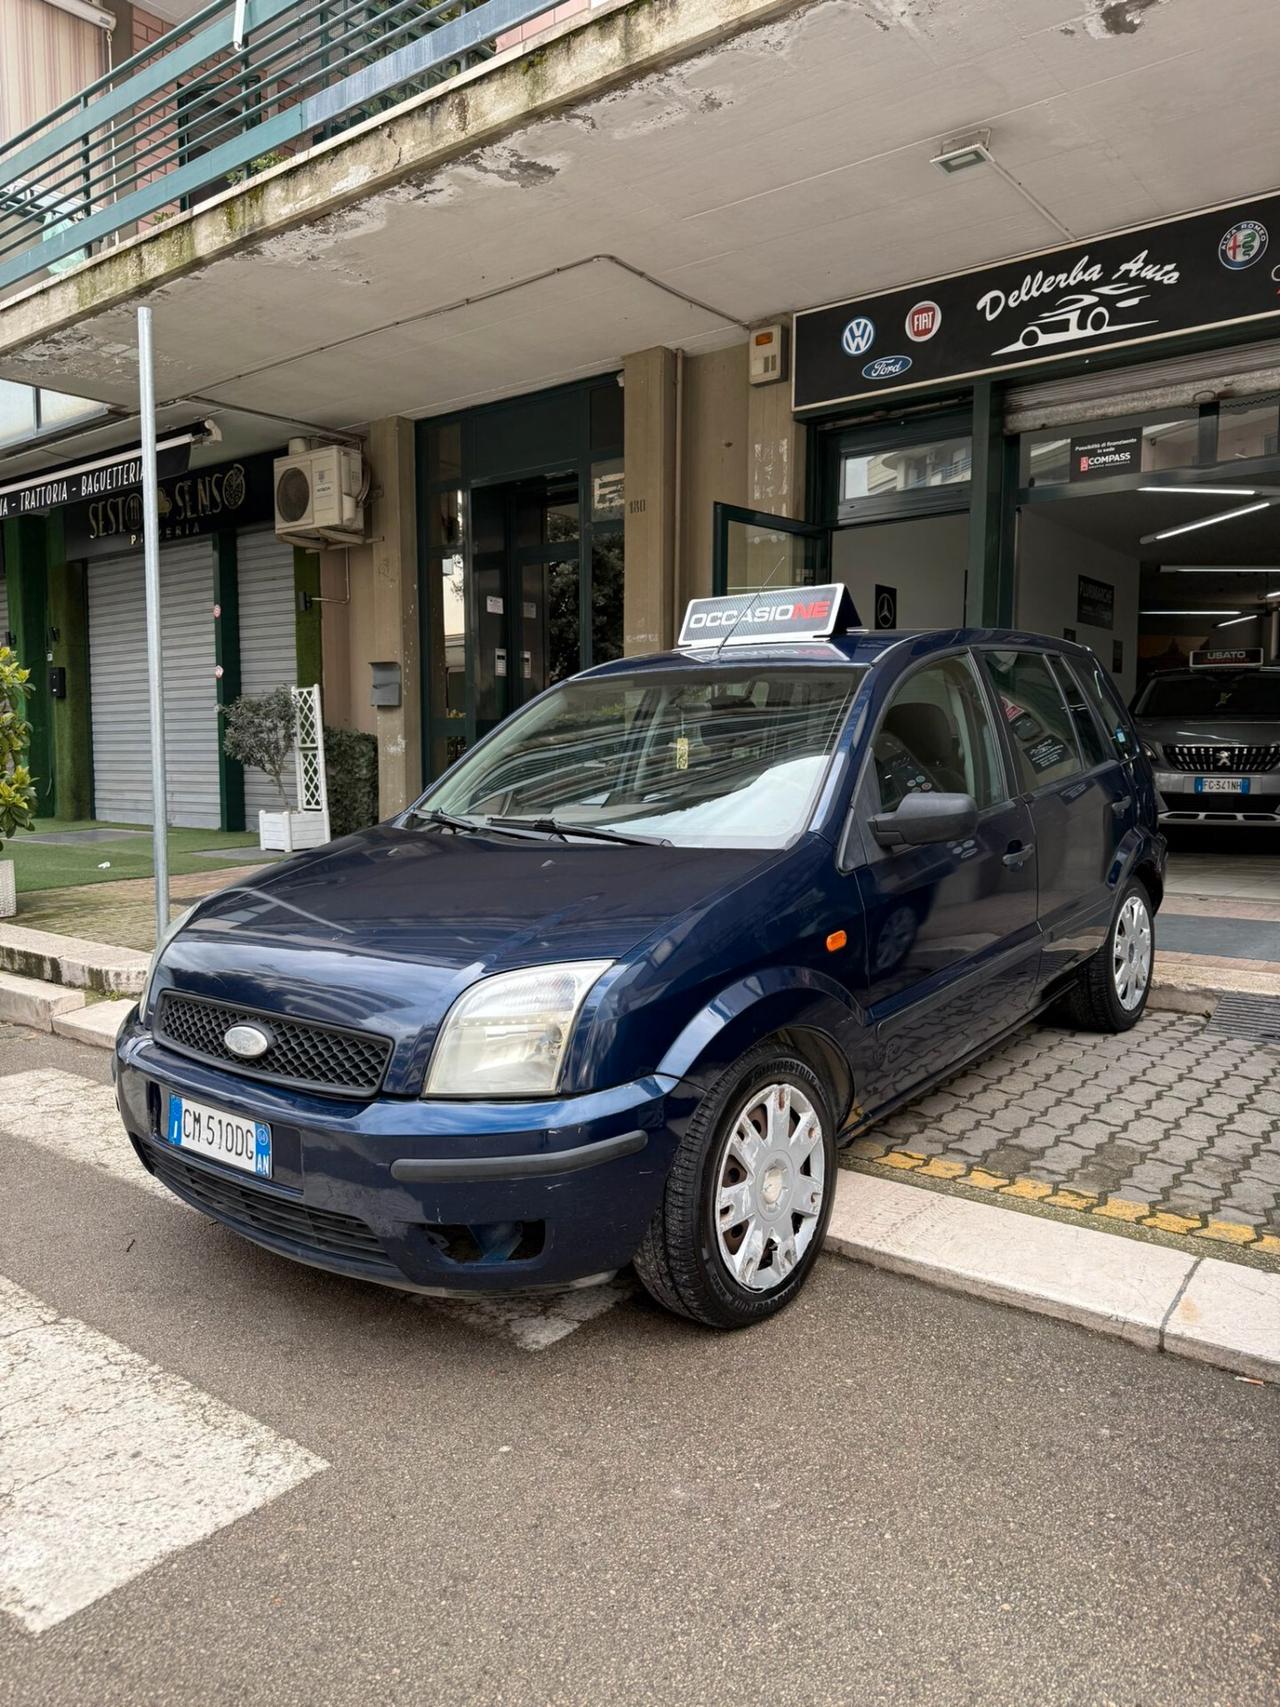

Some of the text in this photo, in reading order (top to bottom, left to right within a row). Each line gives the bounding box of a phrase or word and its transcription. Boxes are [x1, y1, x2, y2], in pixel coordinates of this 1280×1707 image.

[1241, 223, 1266, 242] ROMEO
[976, 249, 1180, 322] Dellerba Auto
[913, 311, 934, 332] FIAT
[871, 358, 902, 377] Ford
[1088, 452, 1131, 465] COMPASS
[20, 481, 68, 511] TRATTORIA
[689, 601, 830, 629] OCCASIONE
[1207, 651, 1246, 660] USATO
[257, 1153, 270, 1178] AN
